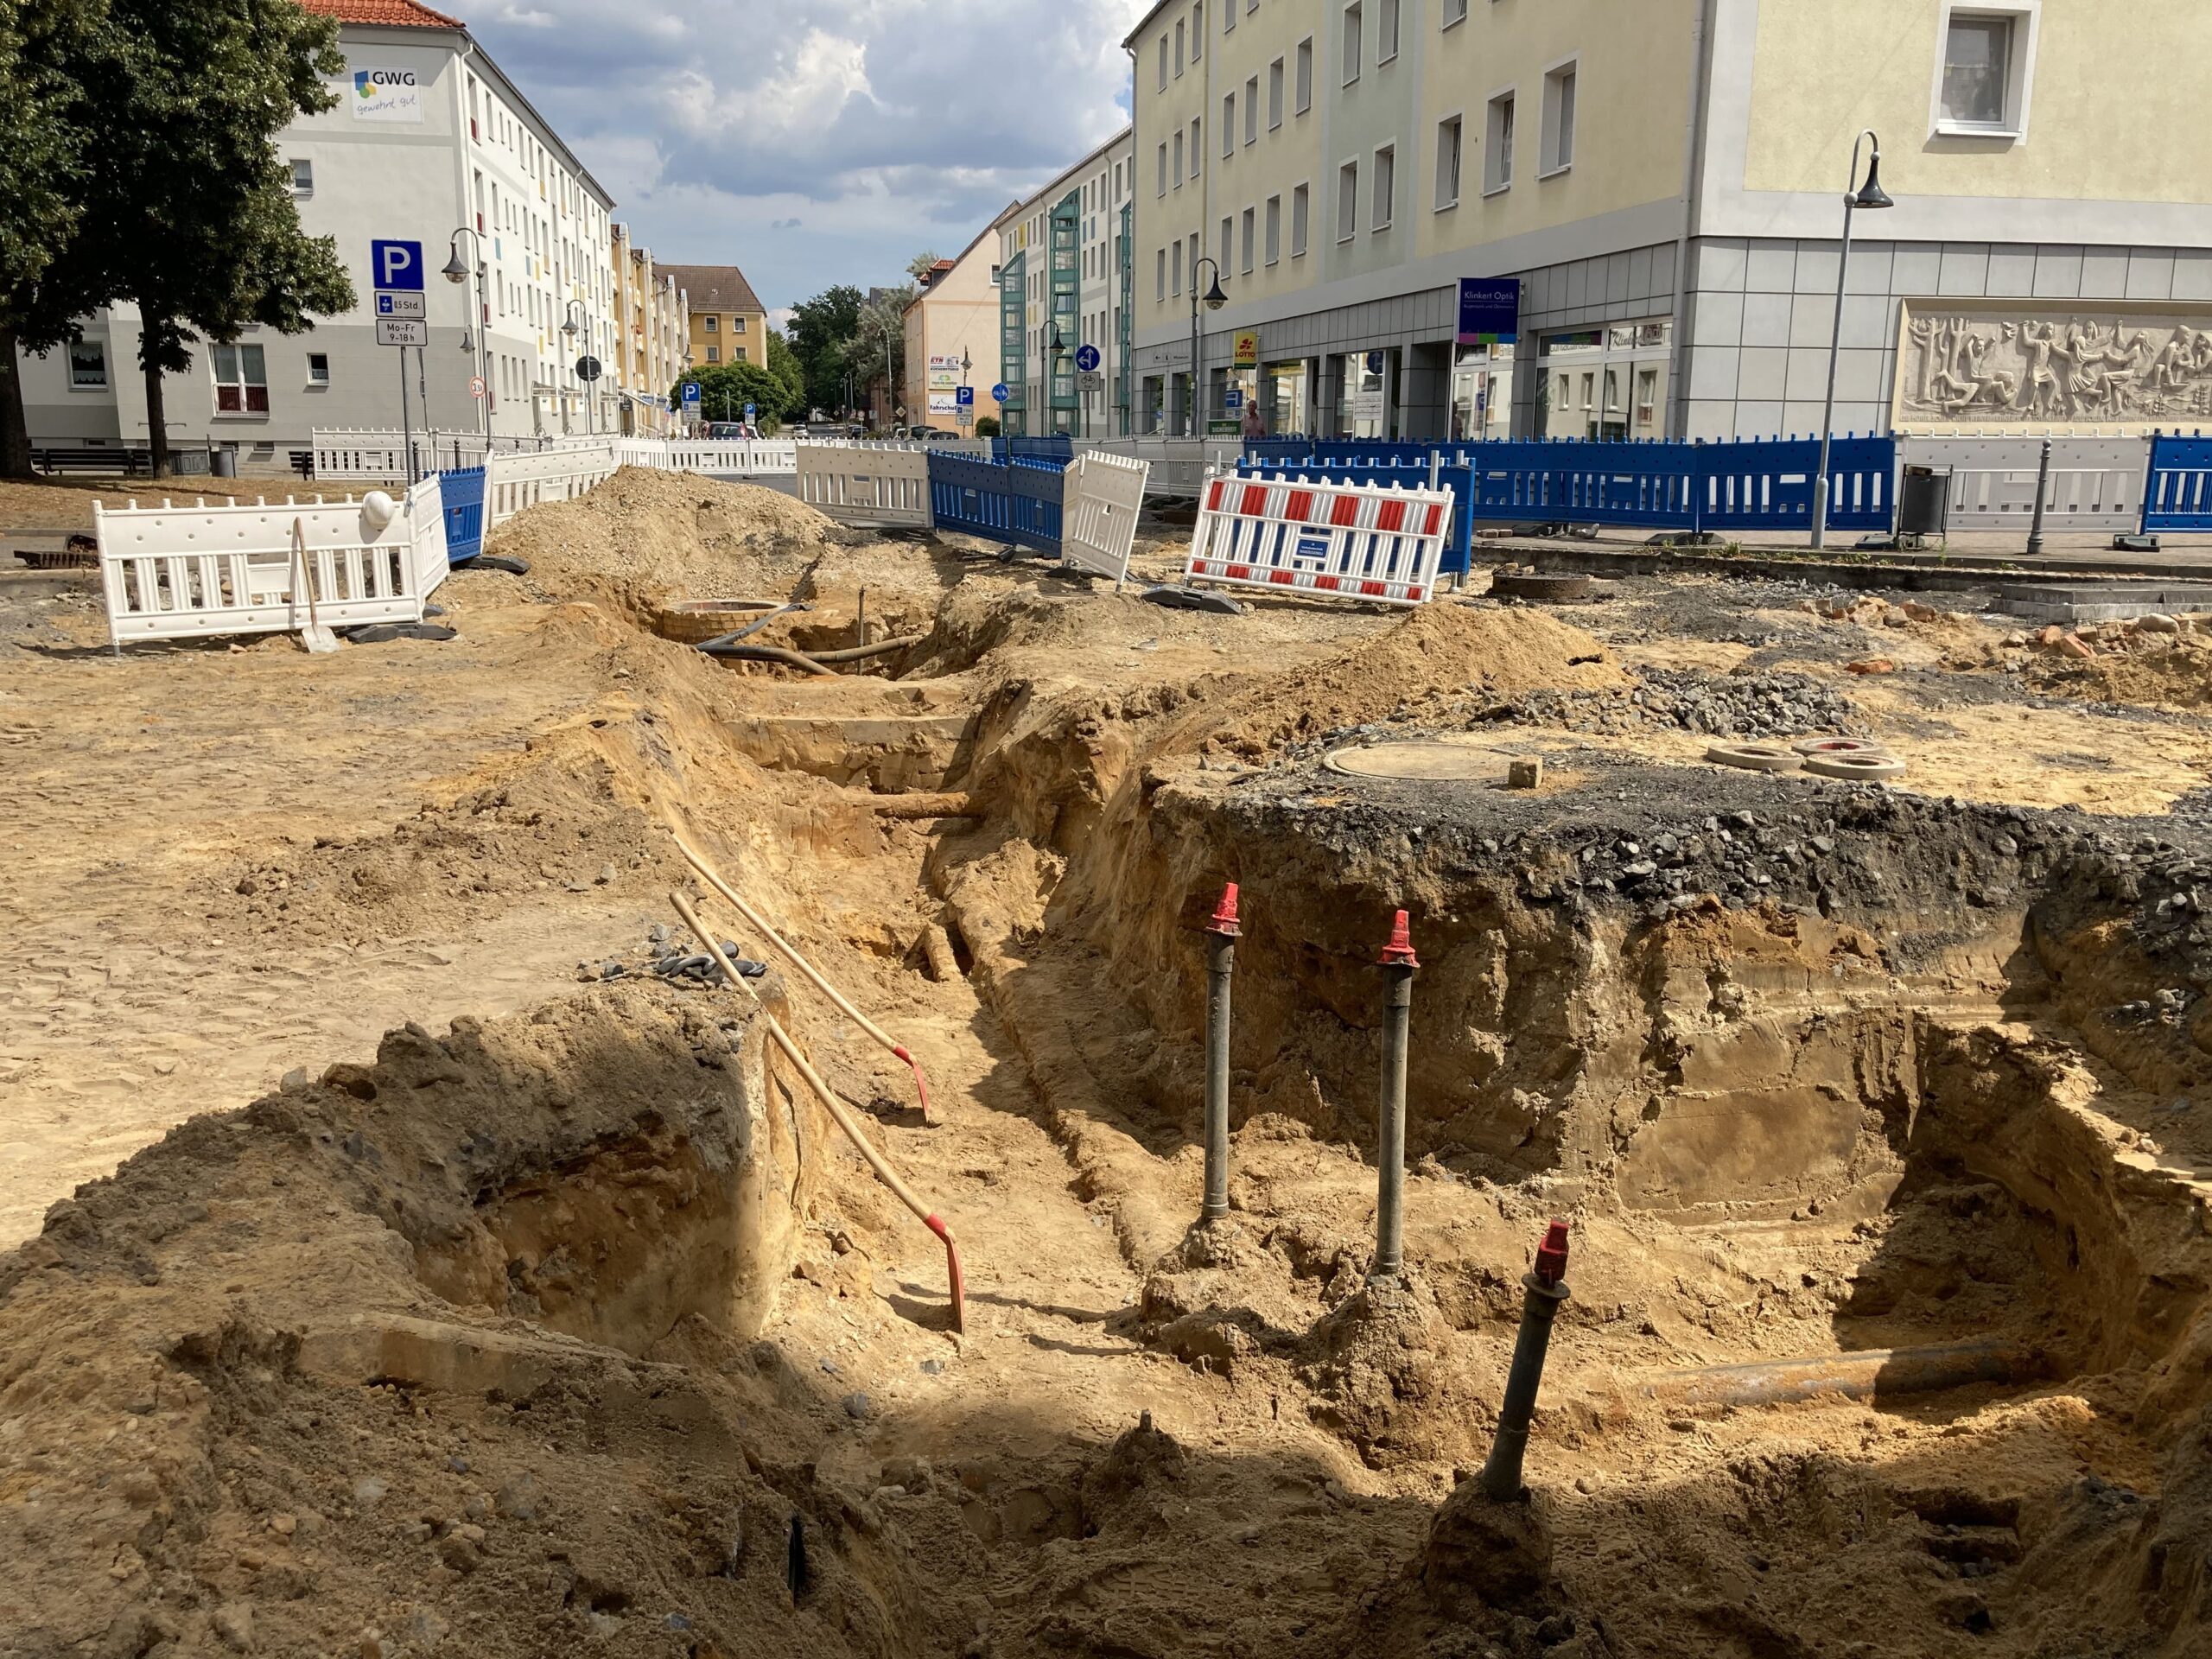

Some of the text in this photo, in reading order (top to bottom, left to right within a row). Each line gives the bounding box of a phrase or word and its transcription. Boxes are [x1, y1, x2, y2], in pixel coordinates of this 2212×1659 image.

[372, 71, 415, 86] GWG
[400, 94, 416, 108] gut
[384, 246, 411, 283] P
[1494, 291, 1515, 302] Optik
[685, 385, 696, 400] P
[960, 389, 970, 403] P
[747, 404, 753, 413] P
